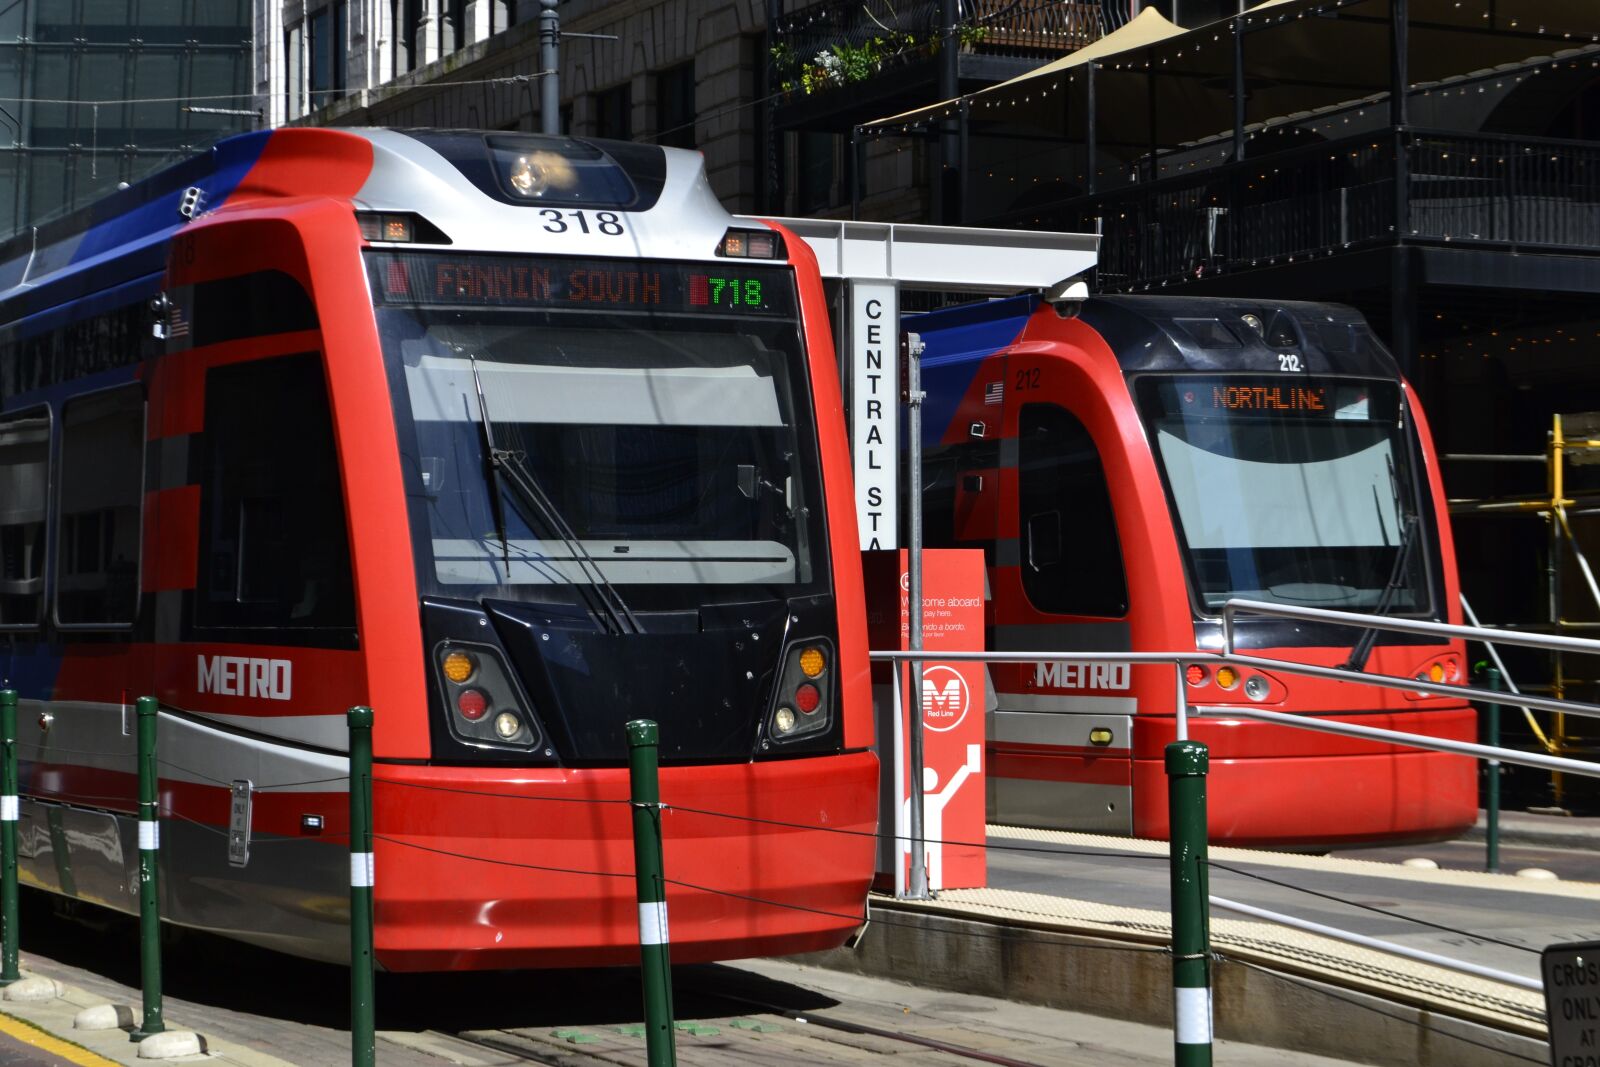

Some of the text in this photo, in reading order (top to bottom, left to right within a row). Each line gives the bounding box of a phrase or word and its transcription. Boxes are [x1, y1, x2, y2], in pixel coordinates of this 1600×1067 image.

[538, 208, 625, 236] 318
[436, 263, 661, 304] FANNIN SOUTH
[708, 277, 762, 305] 718
[1278, 354, 1301, 372] 212
[1015, 367, 1041, 392] 212
[1212, 386, 1326, 411] NORTHLINE
[865, 299, 883, 551] CENTRAL STA
[947, 596, 982, 607] aboard.
[197, 654, 292, 700] METRO
[1035, 662, 1131, 690] METRO
[927, 710, 954, 718] Red Line
[1553, 963, 1600, 987] CROS
[1581, 1029, 1597, 1048] AT
